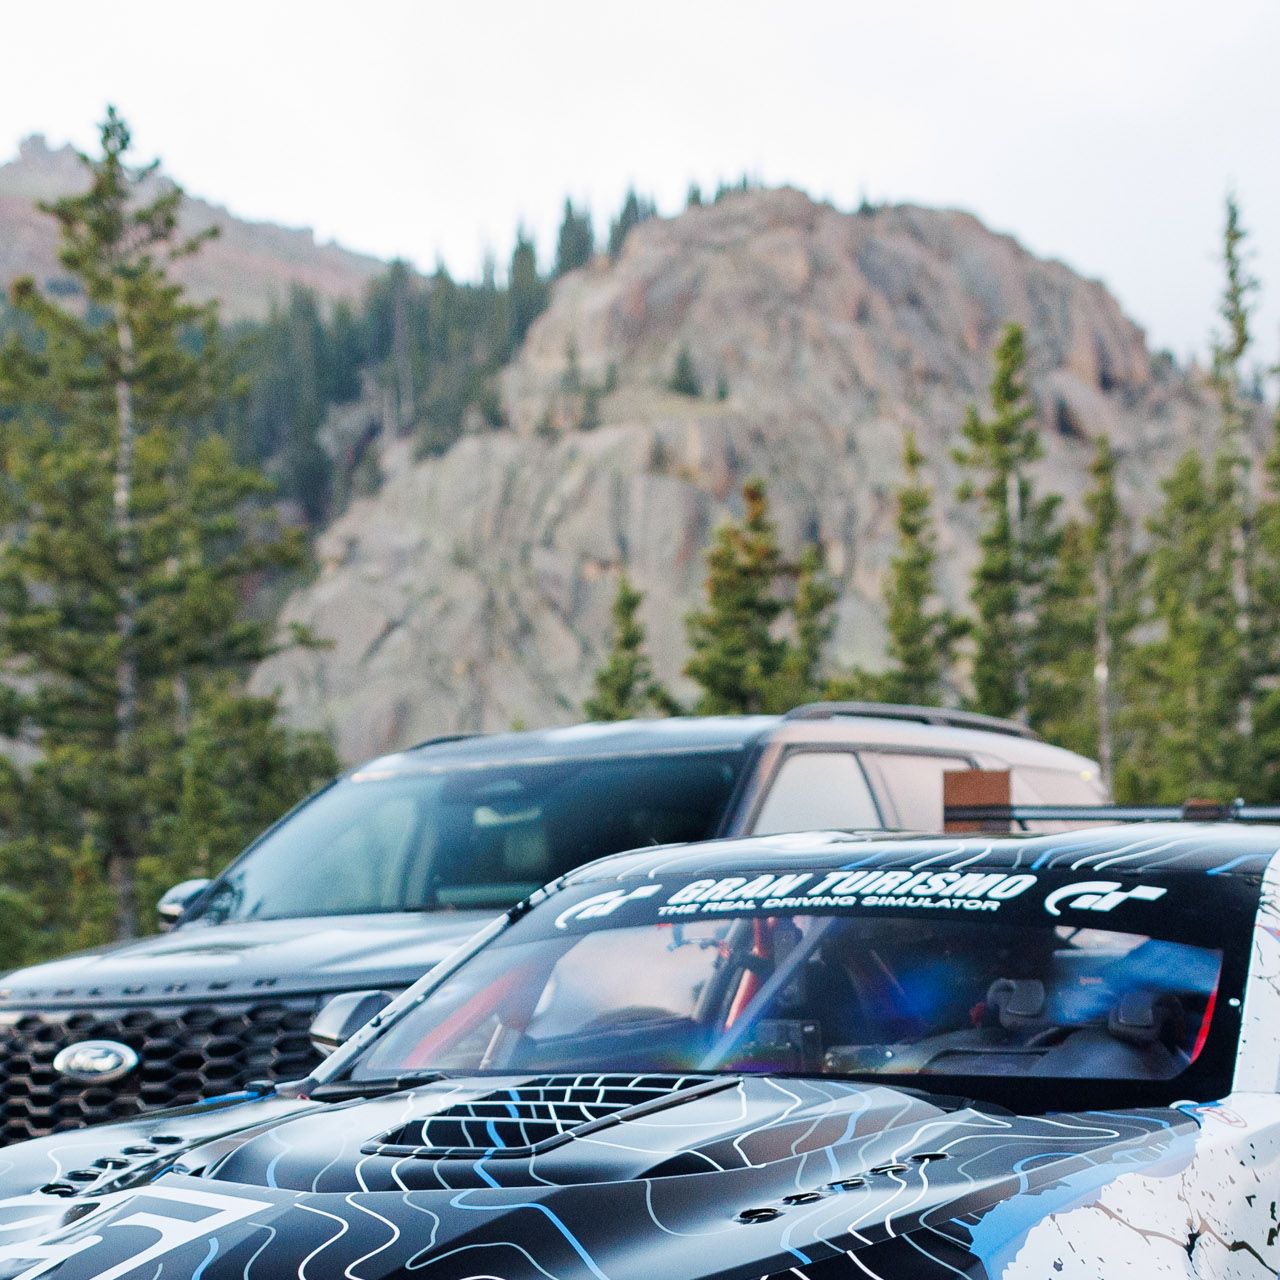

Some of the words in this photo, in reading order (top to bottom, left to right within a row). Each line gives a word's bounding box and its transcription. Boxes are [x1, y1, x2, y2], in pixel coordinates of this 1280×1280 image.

[667, 872, 814, 905] GRAN
[806, 870, 1038, 900] TURISMO
[658, 902, 701, 917] THE
[701, 900, 756, 914] REAL
[760, 895, 855, 910] DRIVING
[861, 895, 1002, 912] SIMULATOR
